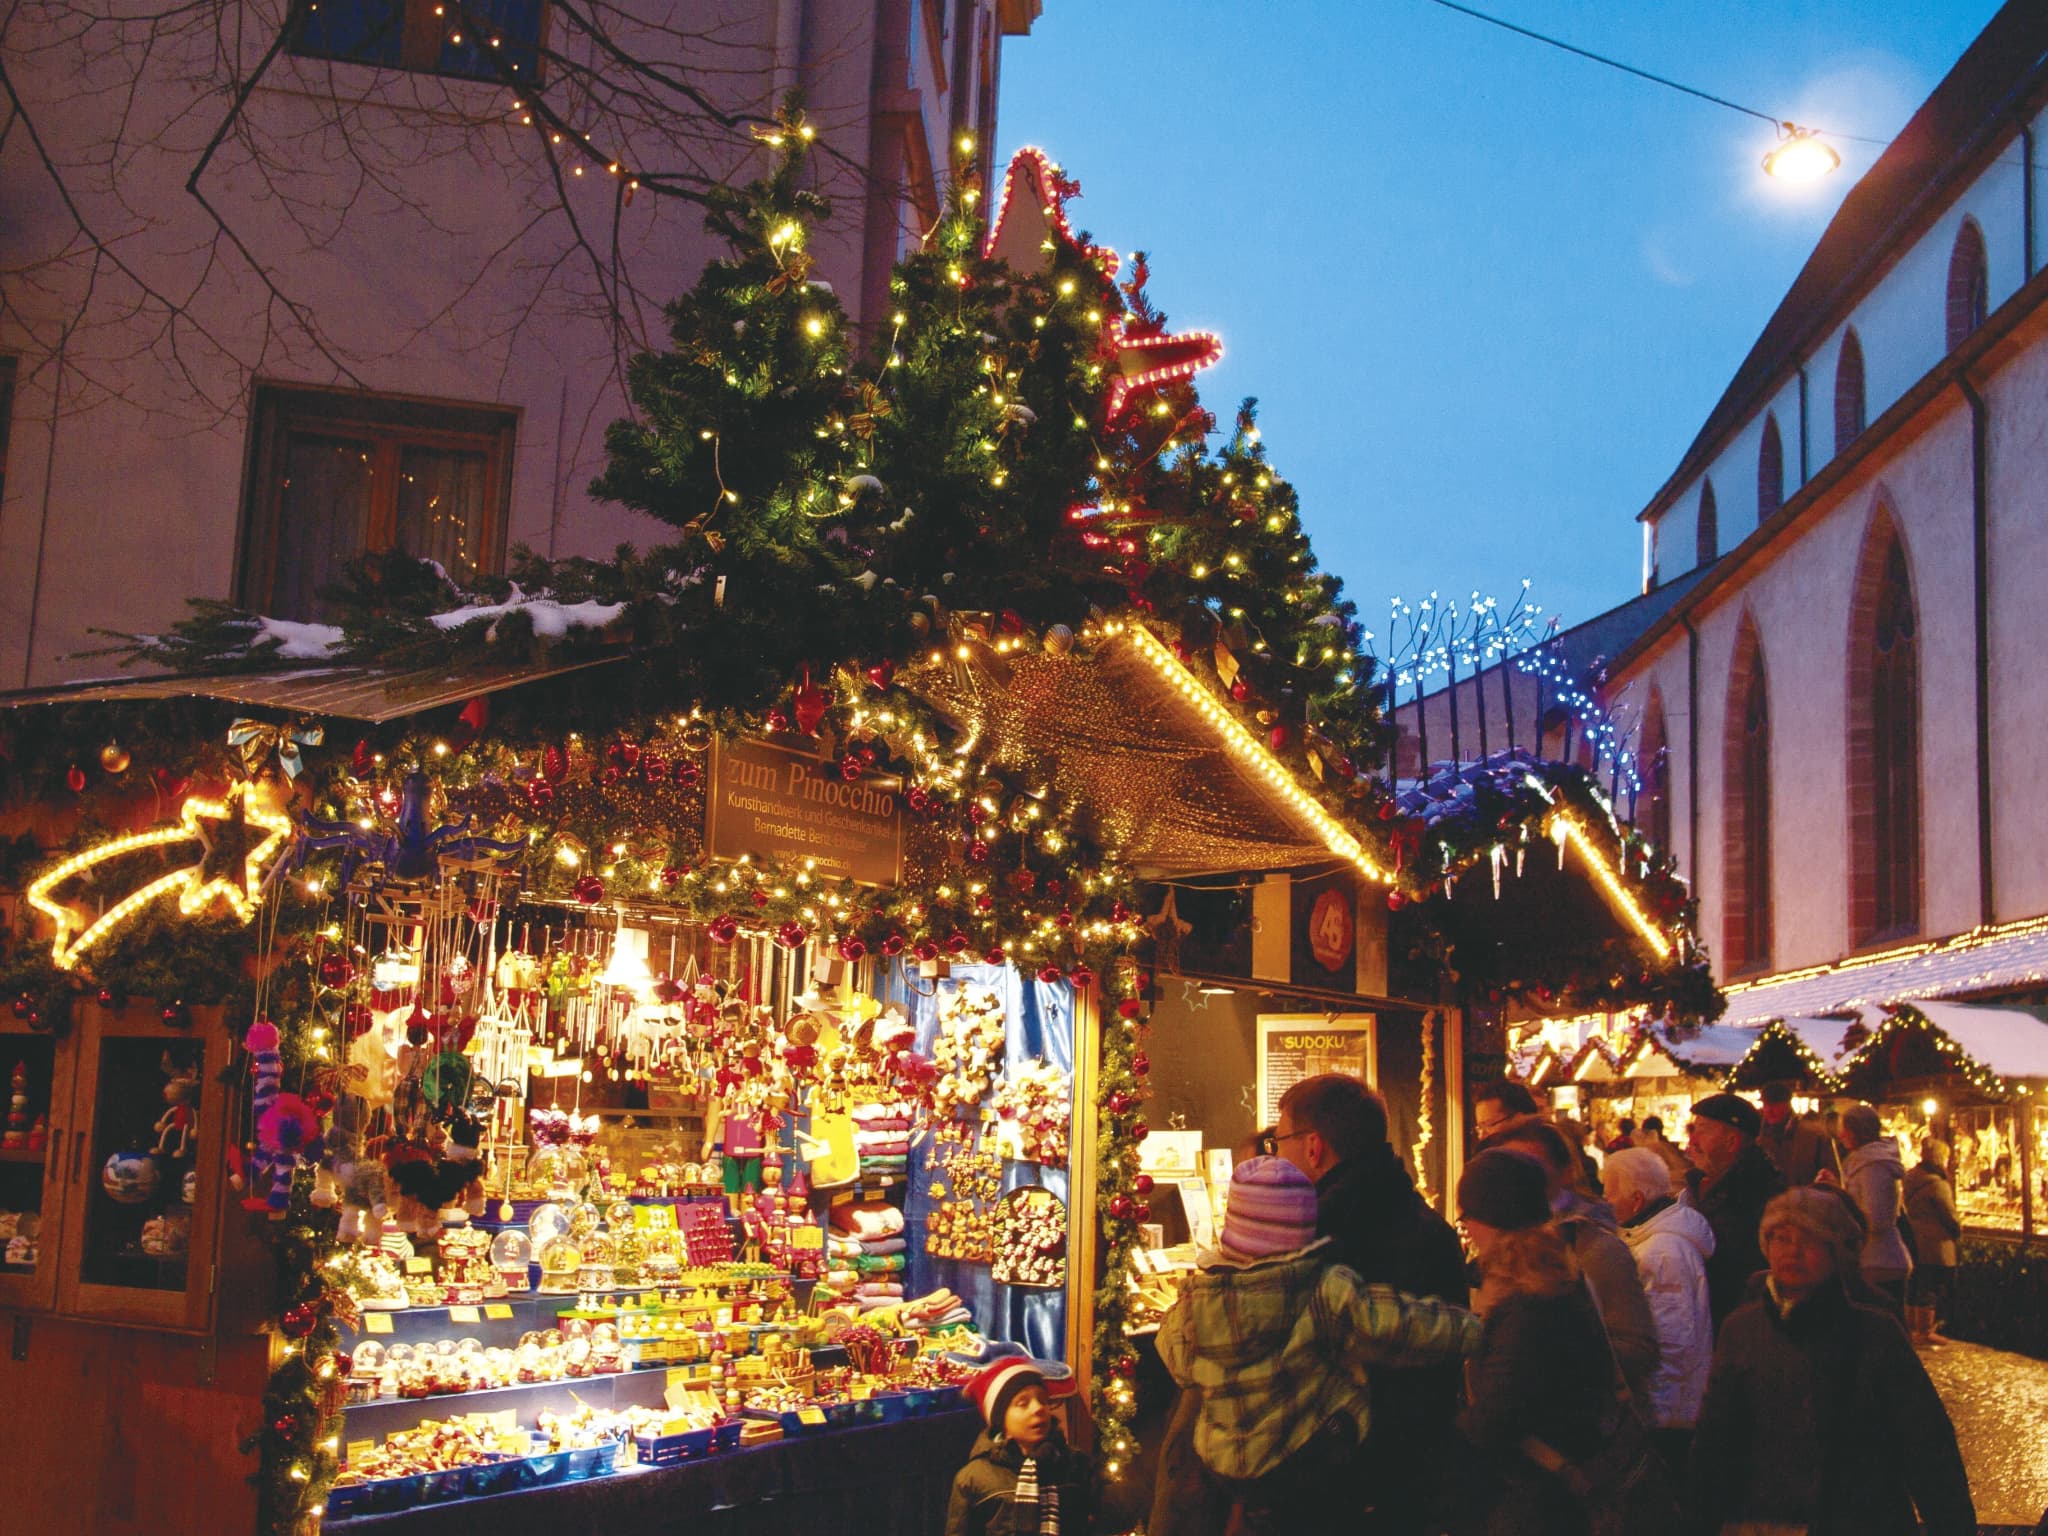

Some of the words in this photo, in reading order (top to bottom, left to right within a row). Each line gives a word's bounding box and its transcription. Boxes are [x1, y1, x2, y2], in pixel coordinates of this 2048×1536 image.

[727, 758, 777, 792] zum
[787, 762, 894, 818] Pinocchio
[728, 791, 803, 820] Kunsthandwerk
[804, 808, 824, 825] und
[754, 816, 806, 842] Bernadette
[1284, 1035, 1345, 1049] SUDOKU
